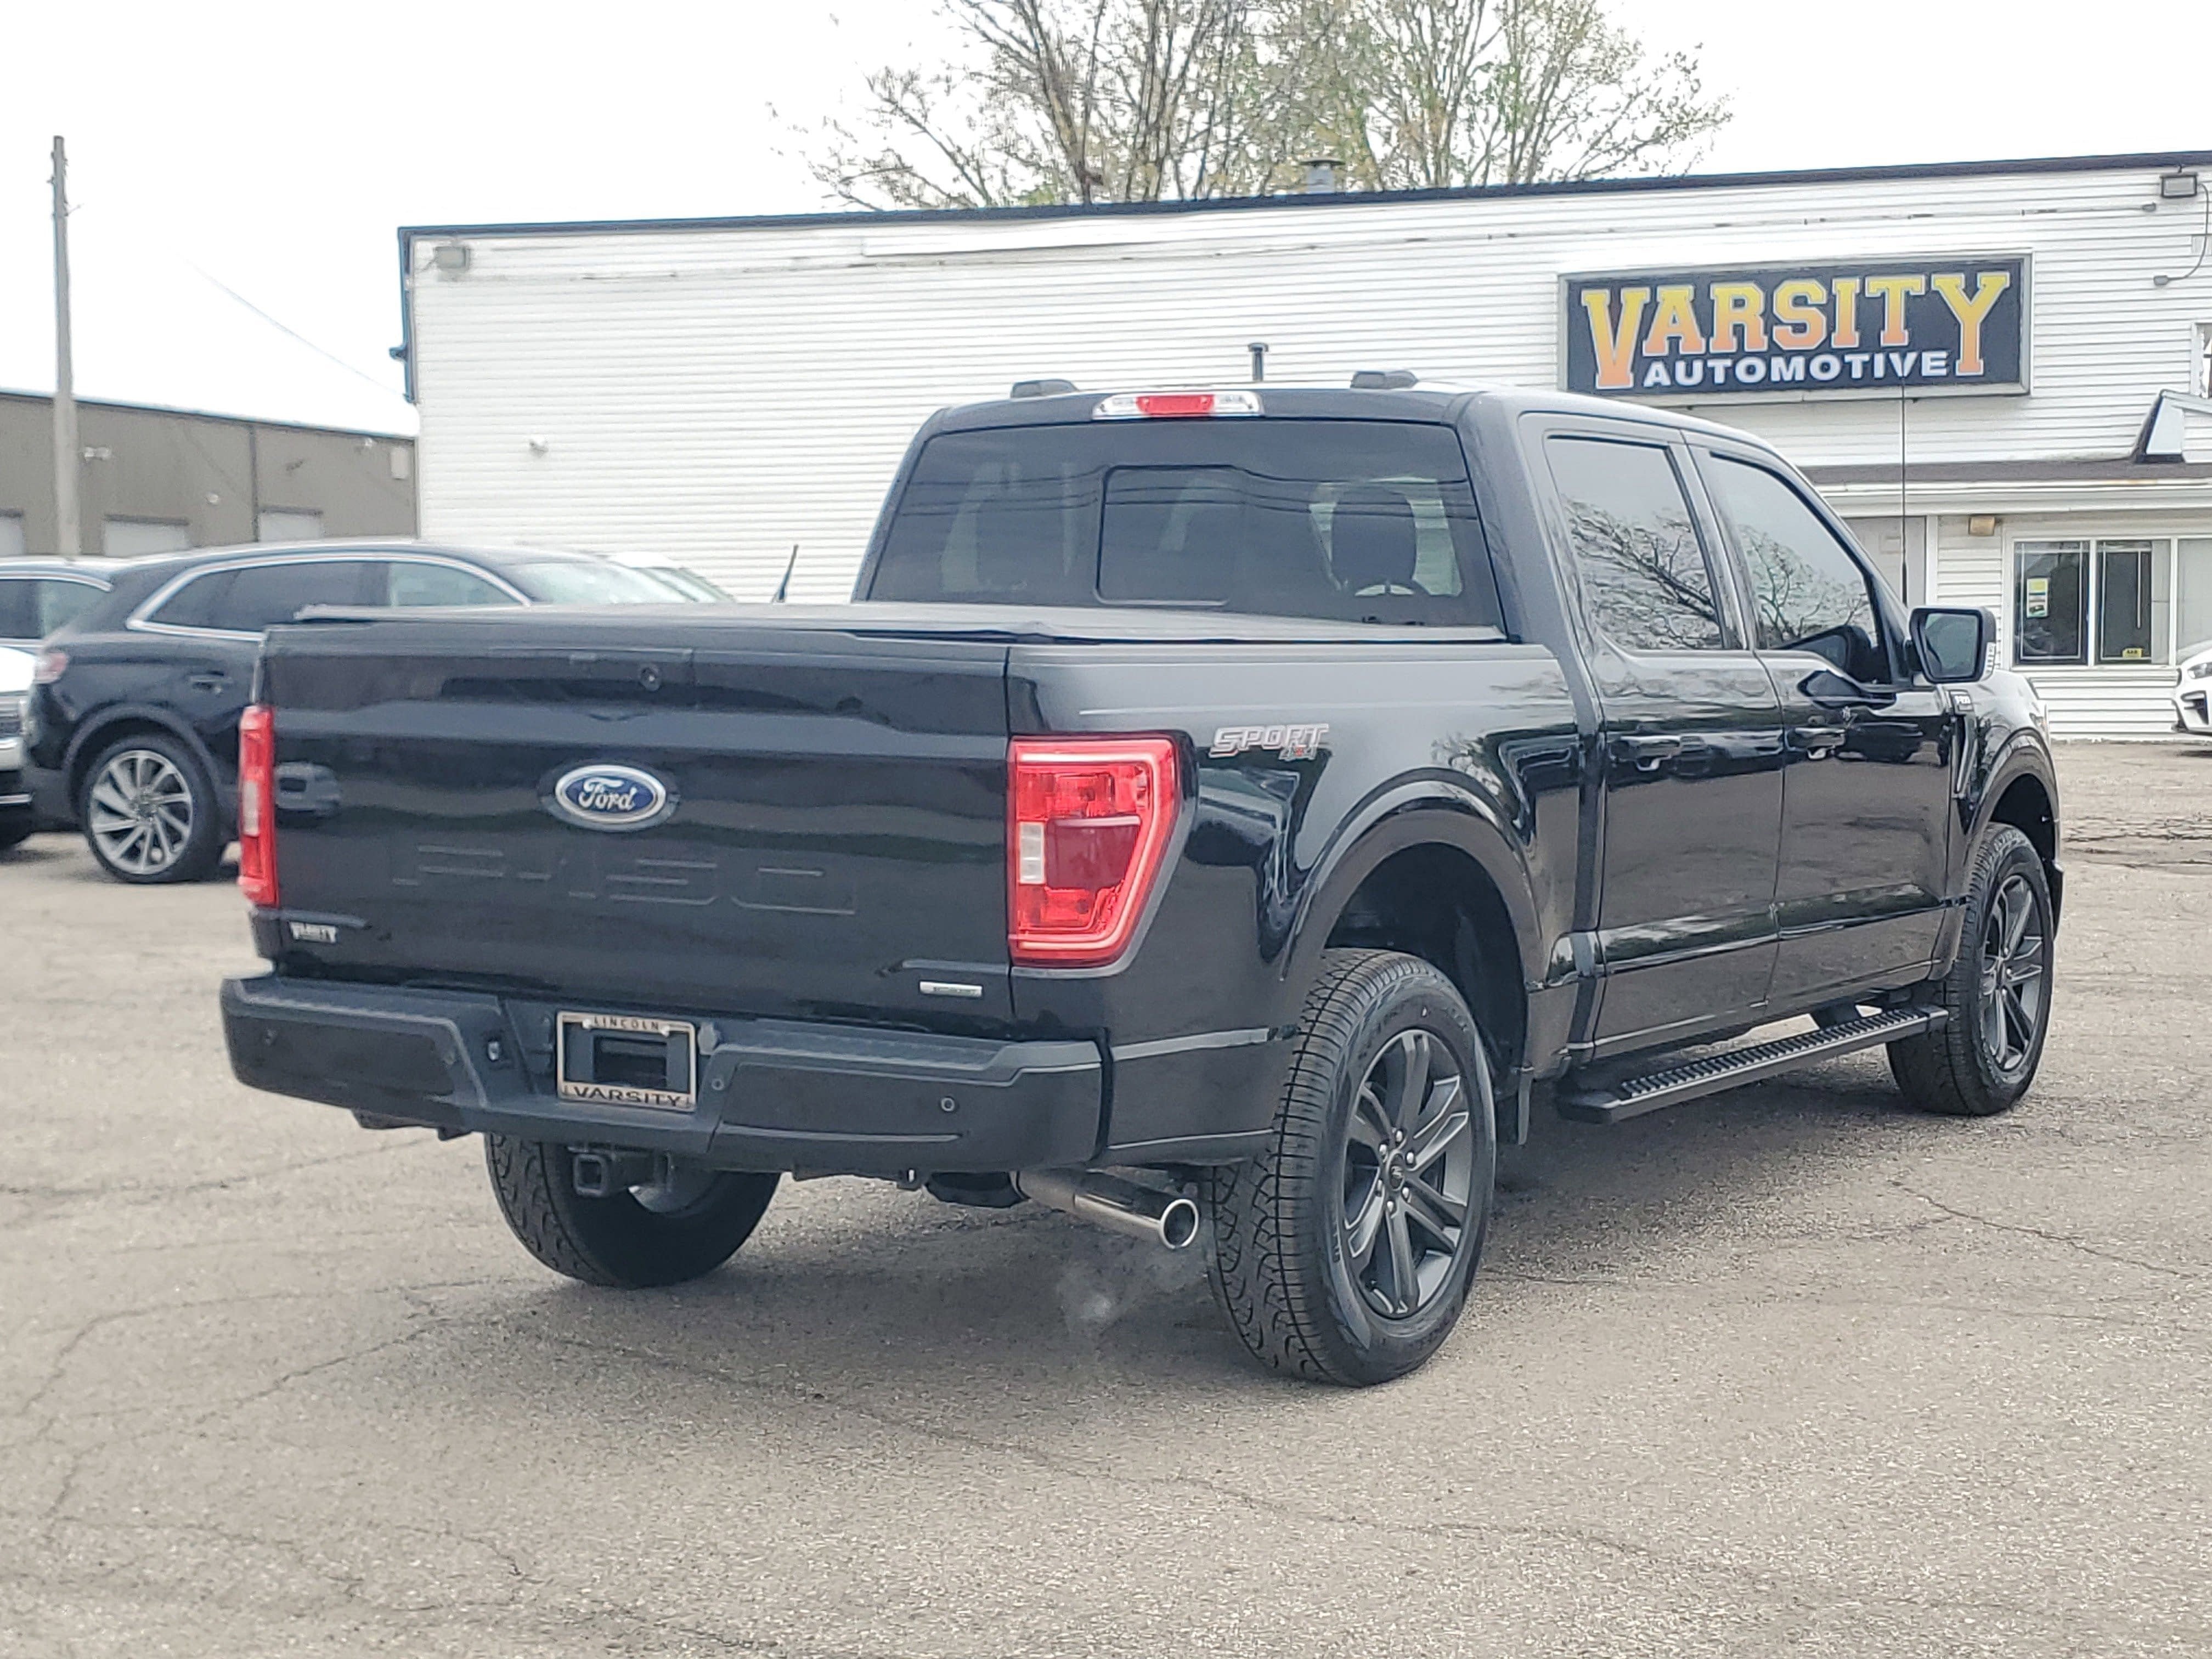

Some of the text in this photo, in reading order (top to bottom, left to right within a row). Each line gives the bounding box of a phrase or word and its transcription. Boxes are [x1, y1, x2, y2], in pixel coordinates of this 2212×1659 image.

[1581, 271, 2011, 390] VARSITY
[1643, 349, 1949, 387] AUTOMOTIVE
[1209, 723, 1329, 758] SPORT
[578, 777, 637, 811] Ford
[594, 1017, 659, 1030] LINCOLN
[574, 1086, 682, 1107] VARSITY
